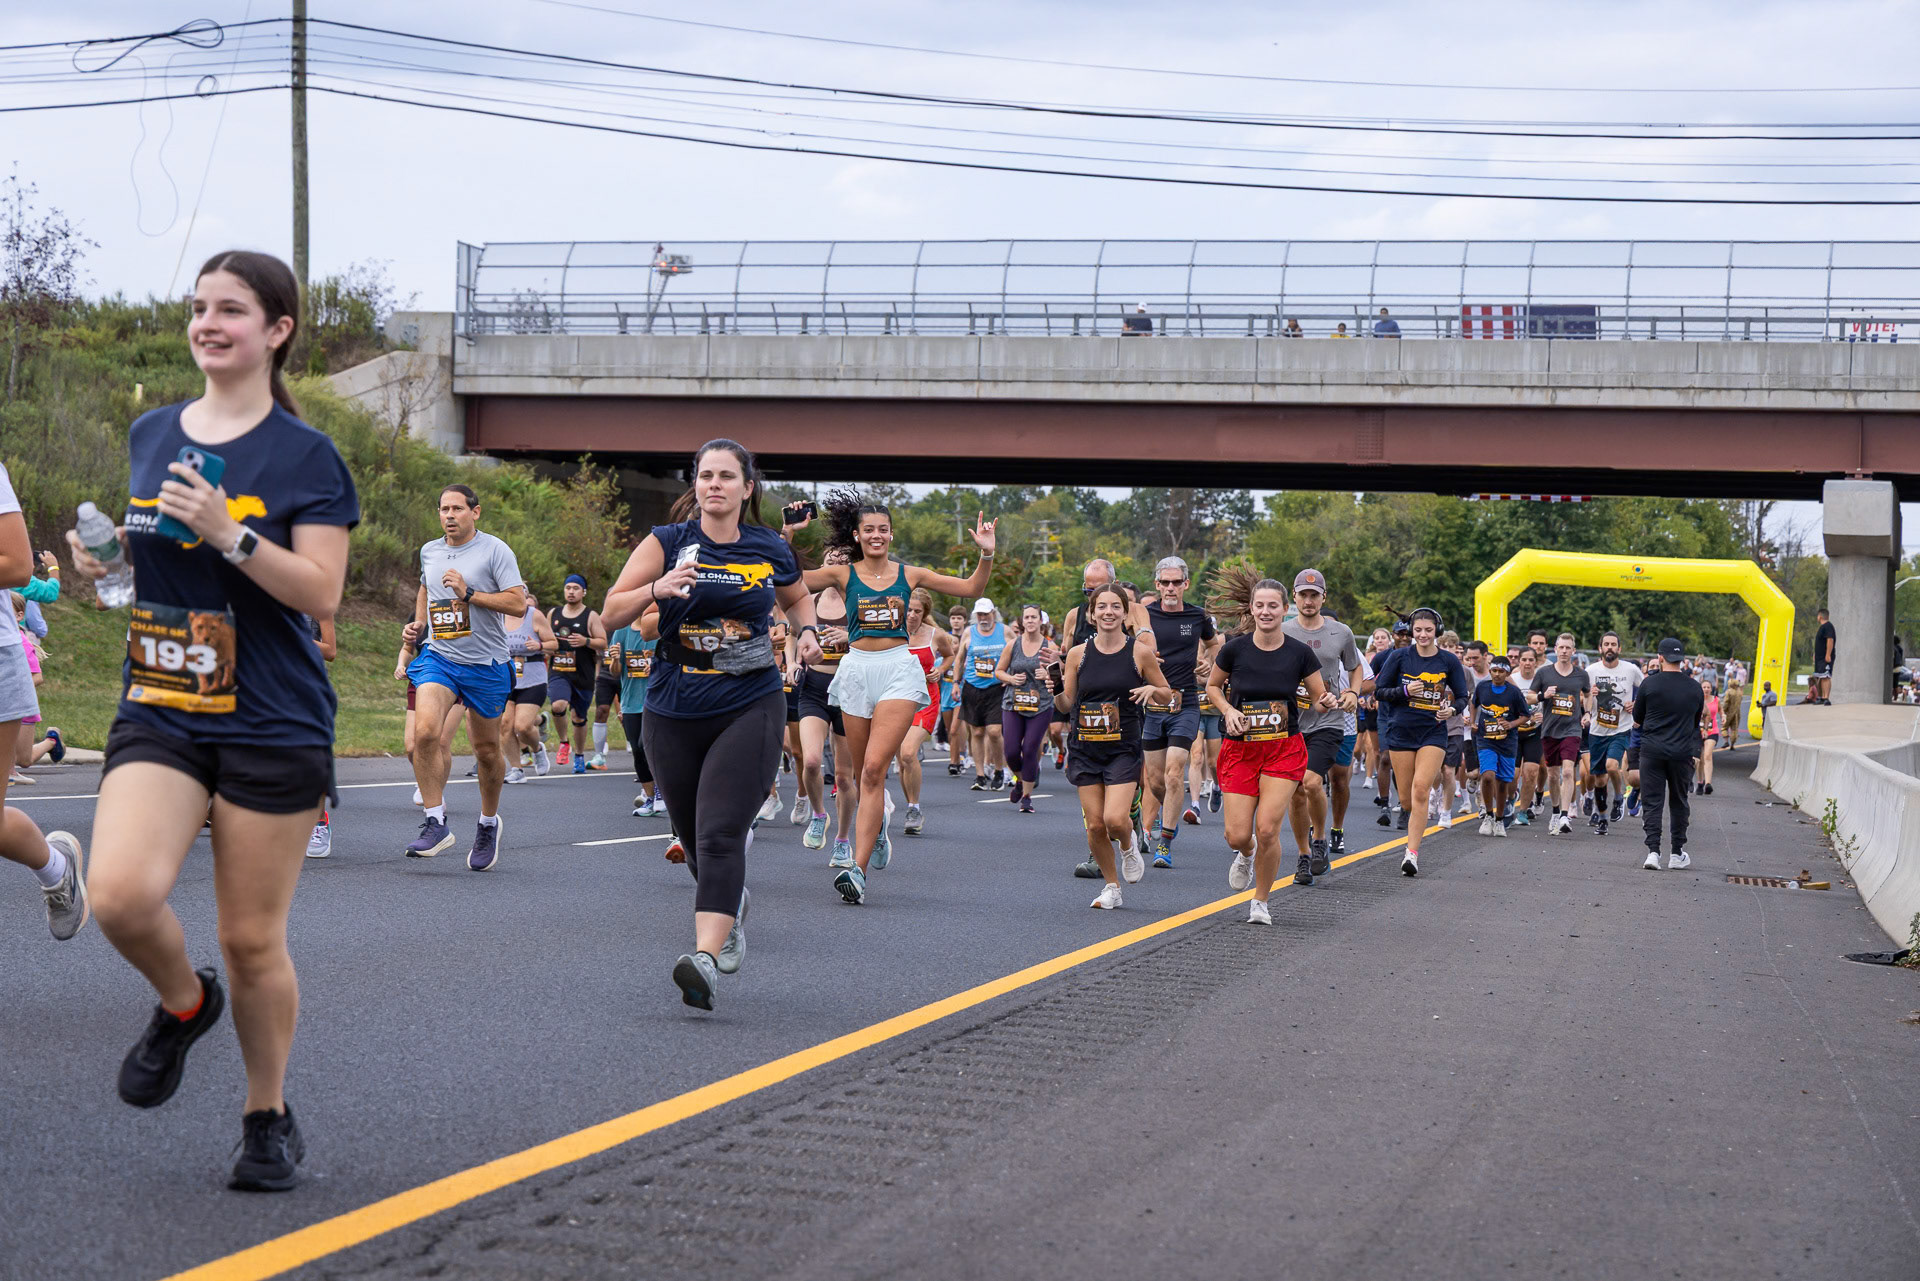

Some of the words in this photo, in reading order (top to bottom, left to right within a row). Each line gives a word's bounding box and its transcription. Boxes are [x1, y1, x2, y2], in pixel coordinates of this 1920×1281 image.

[707, 572, 742, 581] CHASE
[131, 607, 153, 620] THE
[433, 611, 463, 625] 391
[864, 608, 899, 622] 221
[130, 620, 168, 635] CHASE
[140, 636, 217, 675] 193
[553, 656, 574, 664] 340
[629, 658, 652, 667] 361
[1084, 715, 1110, 727] 171
[1250, 713, 1282, 727] 170
